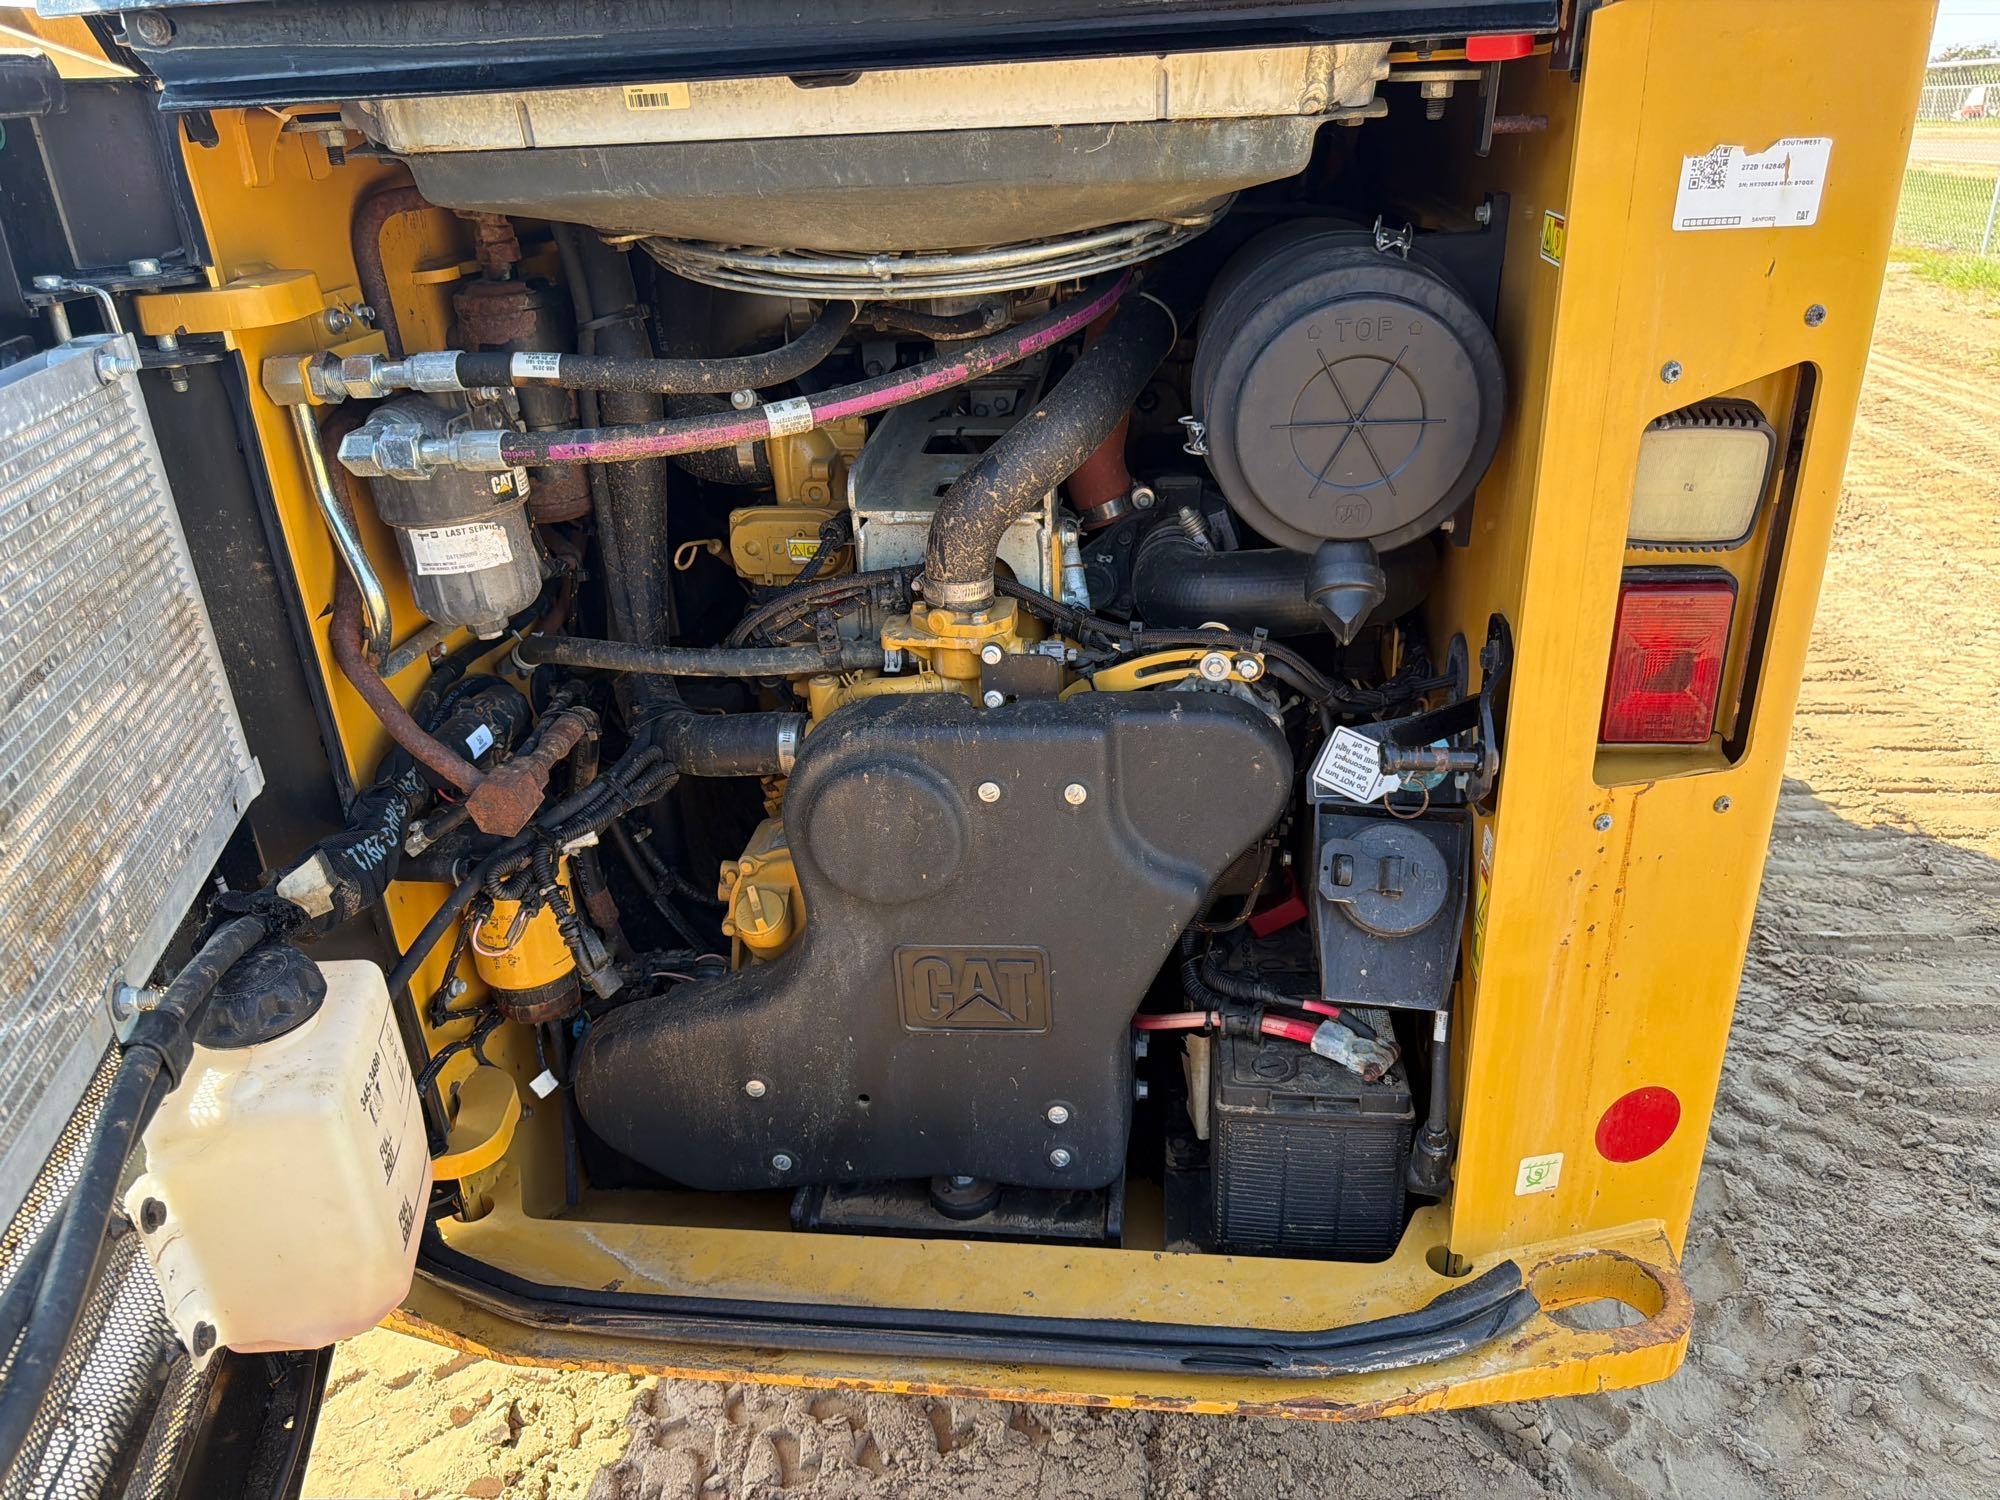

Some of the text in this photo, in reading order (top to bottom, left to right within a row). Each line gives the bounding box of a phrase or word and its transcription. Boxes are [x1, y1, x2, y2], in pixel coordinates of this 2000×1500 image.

[1781, 139, 1821, 147] SOUTHWEST
[1796, 210, 1809, 221] CAT
[1335, 317, 1393, 342] TOP
[490, 472, 513, 495] CAT
[445, 528, 467, 538] LAST
[1335, 742, 1351, 755] light
[1352, 741, 1363, 749] off
[1352, 750, 1363, 760] the
[1325, 768, 1367, 793] Do NOT turn
[1332, 761, 1356, 777] battery
[912, 955, 1037, 1023] CAT
[360, 1051, 381, 1112] 345-3480
[379, 1129, 392, 1162] FULL
[384, 1146, 396, 1177] HOT
[398, 1194, 410, 1229] FULL
